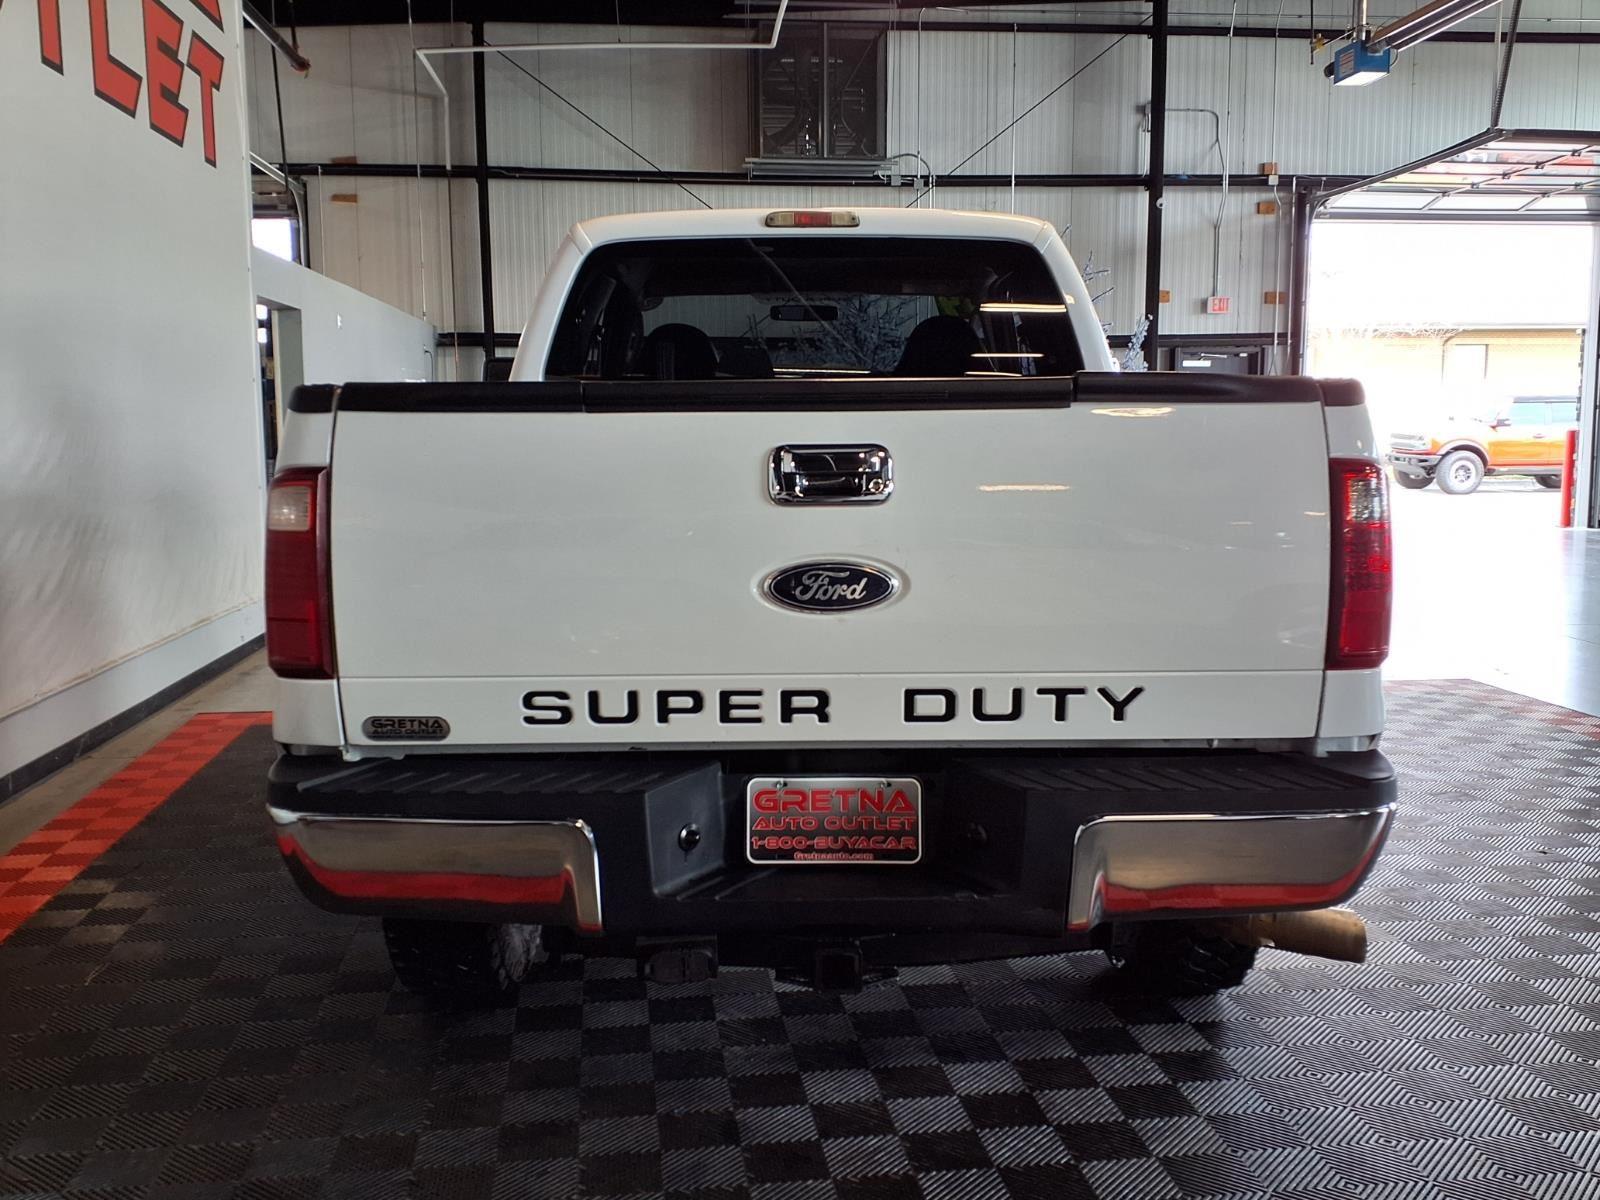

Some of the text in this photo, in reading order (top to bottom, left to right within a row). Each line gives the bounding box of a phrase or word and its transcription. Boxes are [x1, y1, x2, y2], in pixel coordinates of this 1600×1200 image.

[1212, 298, 1229, 312] EXIT
[795, 570, 868, 600] Ford
[521, 687, 1145, 725] SUPER DUTY
[370, 718, 443, 729] GRETNA
[752, 788, 916, 814] GRETNA
[752, 816, 917, 831] AUTO OUTLET
[752, 836, 917, 850] 1-800-BUYACAR
